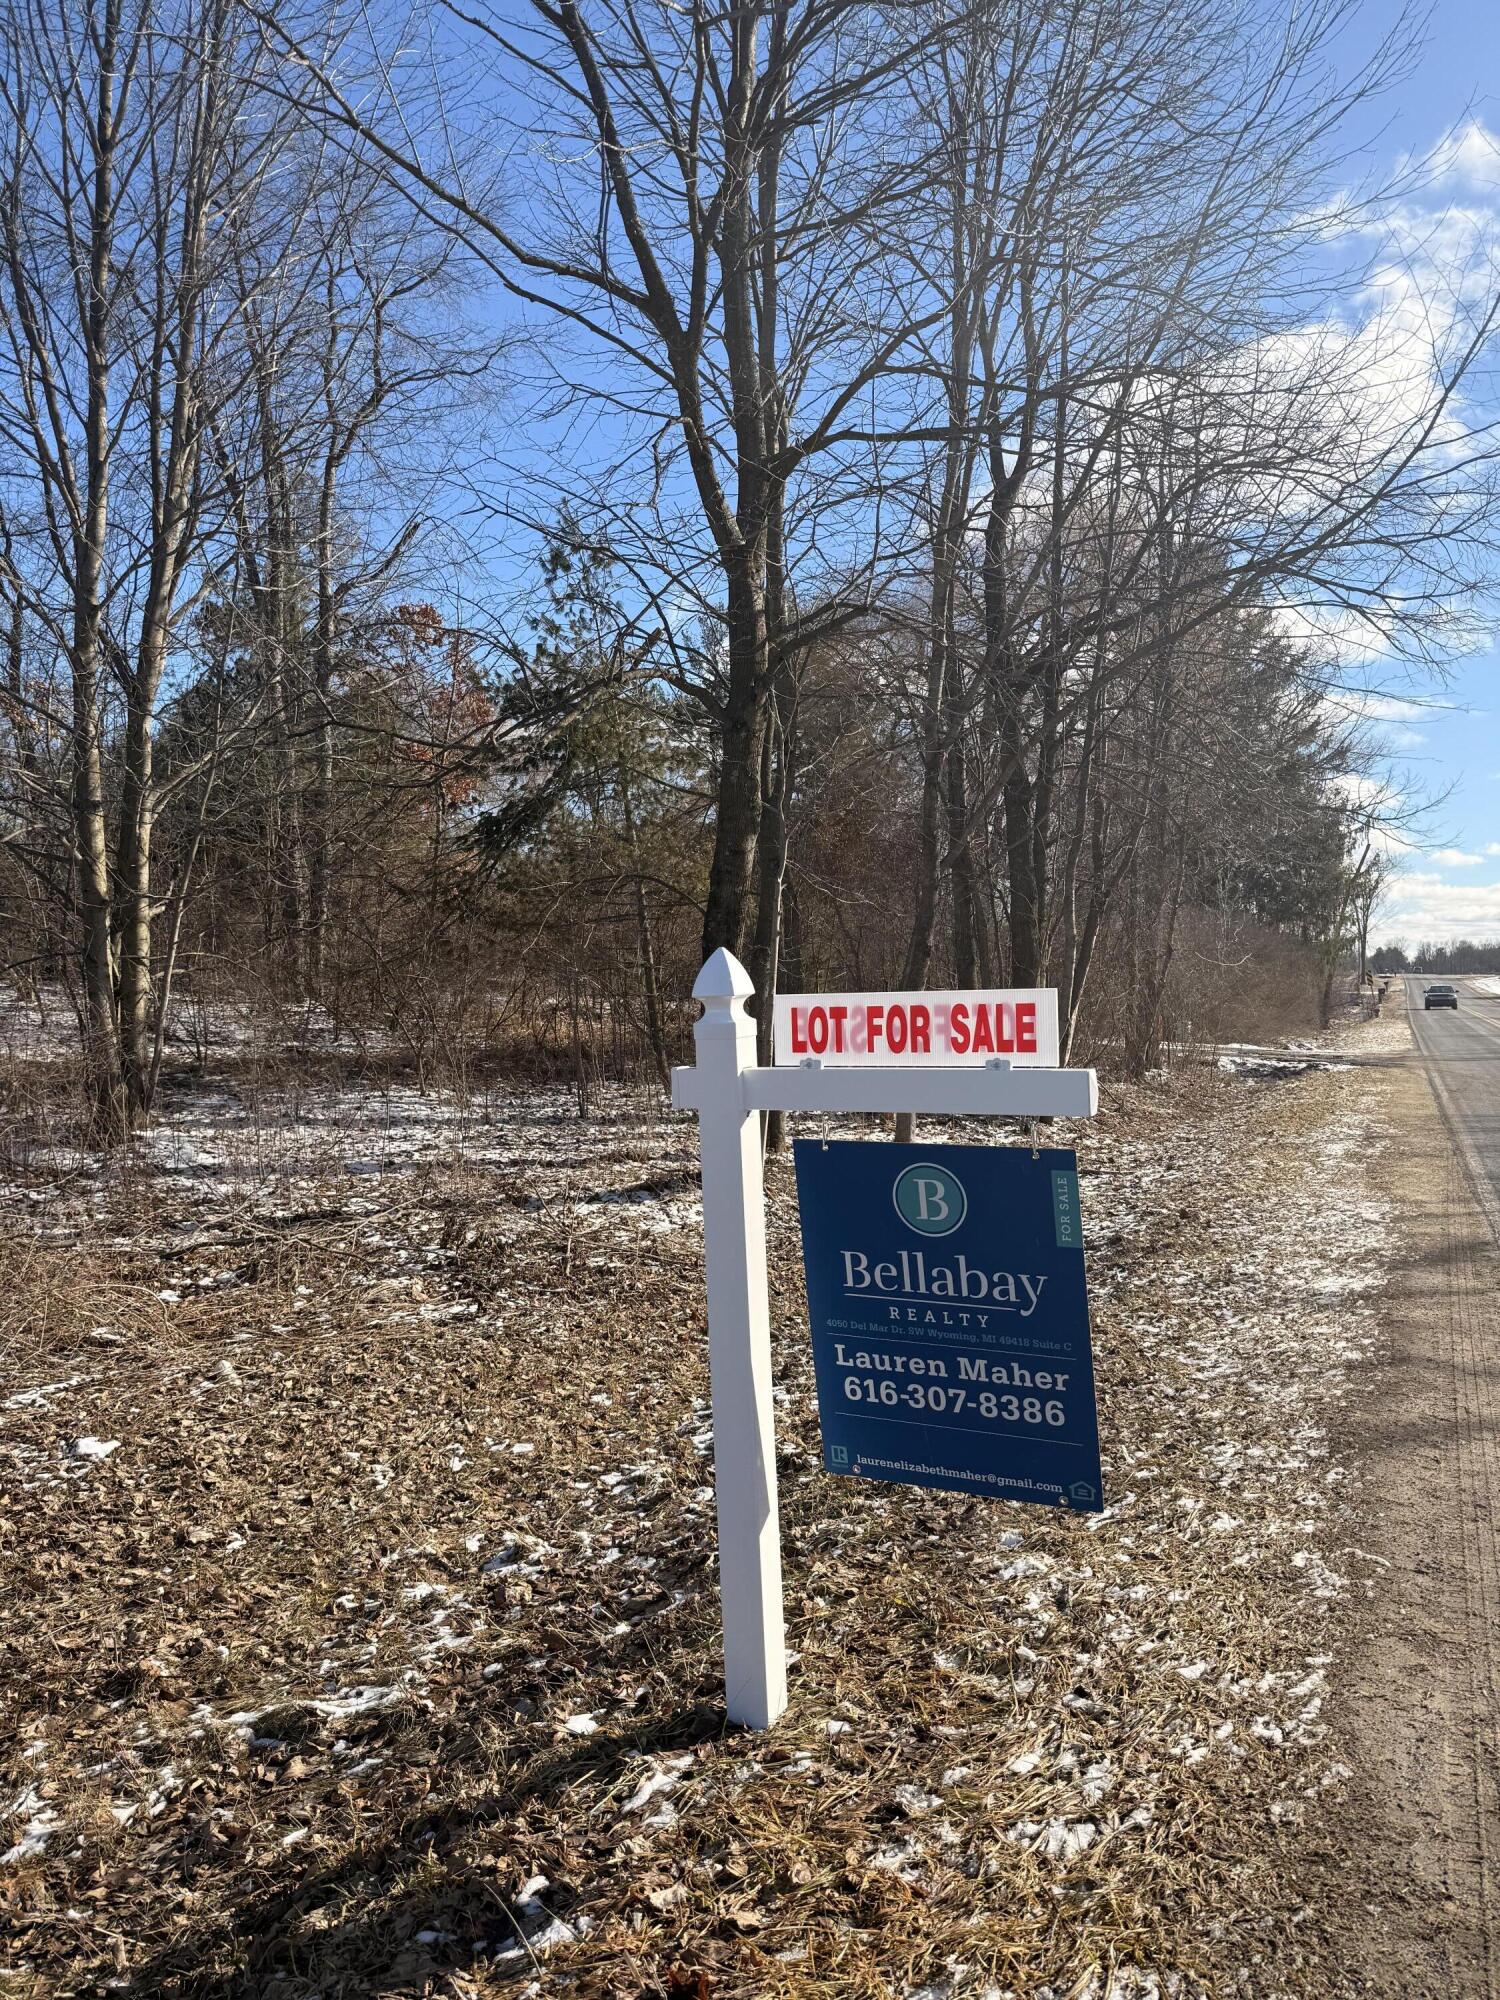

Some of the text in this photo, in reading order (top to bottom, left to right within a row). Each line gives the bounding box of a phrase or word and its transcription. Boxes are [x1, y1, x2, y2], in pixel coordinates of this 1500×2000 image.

[791, 1003, 1037, 1054] LOT FOR SALE
[913, 1179, 949, 1221] B
[1058, 1177, 1072, 1241] FOR SALE
[840, 1250, 1048, 1316] Bellabay
[850, 1321, 867, 1330] Del
[869, 1323, 889, 1333] Mar
[891, 1325, 906, 1334] Dr.
[908, 1327, 925, 1336] SW
[927, 1328, 980, 1343] Wyoming,
[982, 1334, 997, 1344] MI
[1032, 1339, 1061, 1350] Suite
[1063, 1342, 1072, 1351] C
[889, 1307, 990, 1328] REALTY
[834, 1344, 1070, 1392] Lauren Maher
[844, 1377, 1066, 1427] 616-307-8386
[857, 1454, 1063, 1493] laurenelizabethmaher@gmail.com
